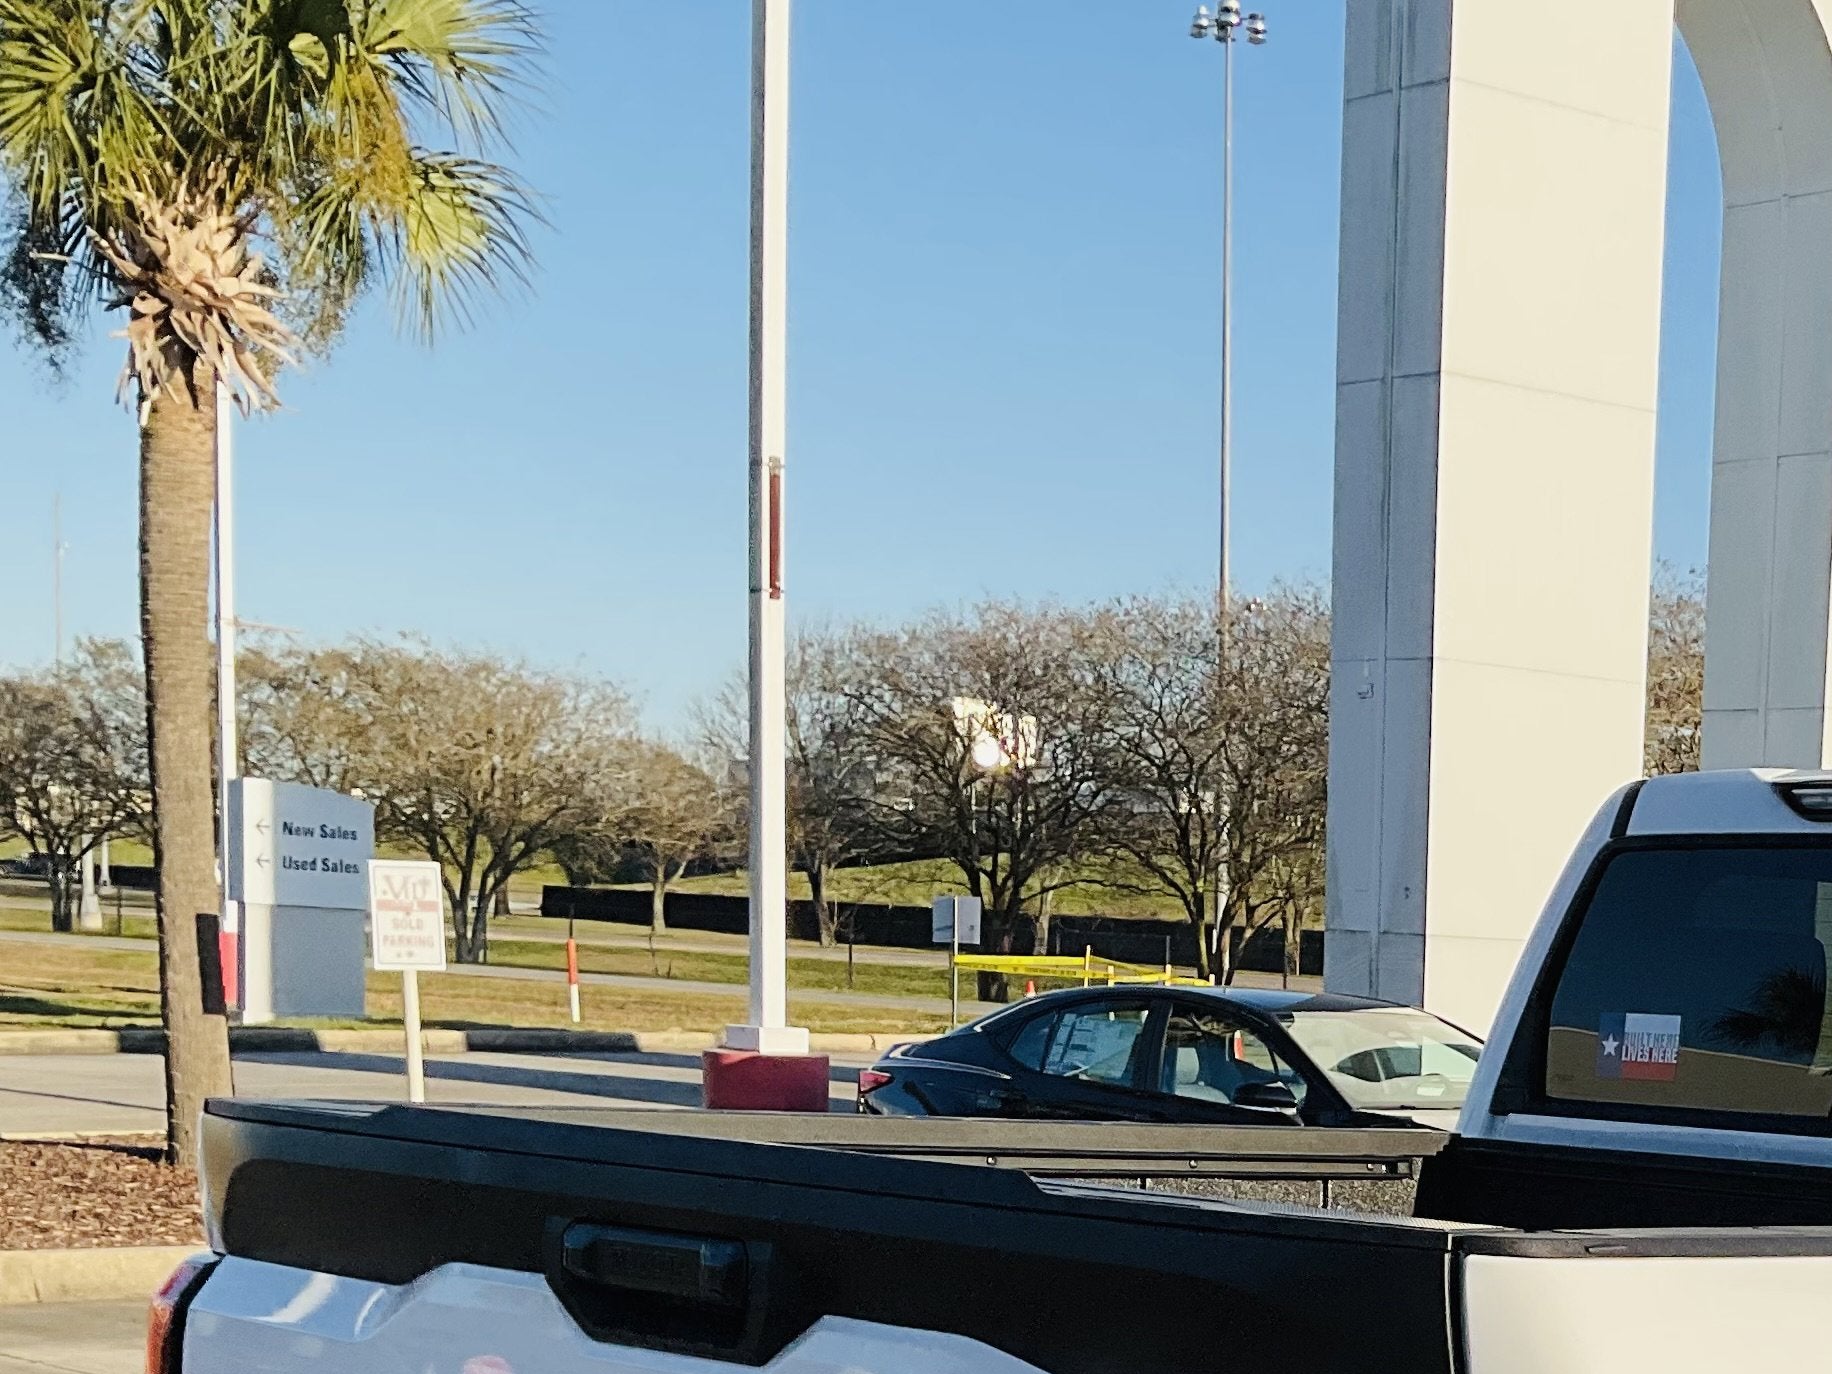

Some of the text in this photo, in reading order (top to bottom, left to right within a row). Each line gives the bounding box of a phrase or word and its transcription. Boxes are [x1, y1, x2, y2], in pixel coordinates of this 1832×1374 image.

[283, 821, 358, 841] New Sales
[282, 856, 360, 874] Used Sales
[1621, 1045, 1678, 1064] LIVES HERE
